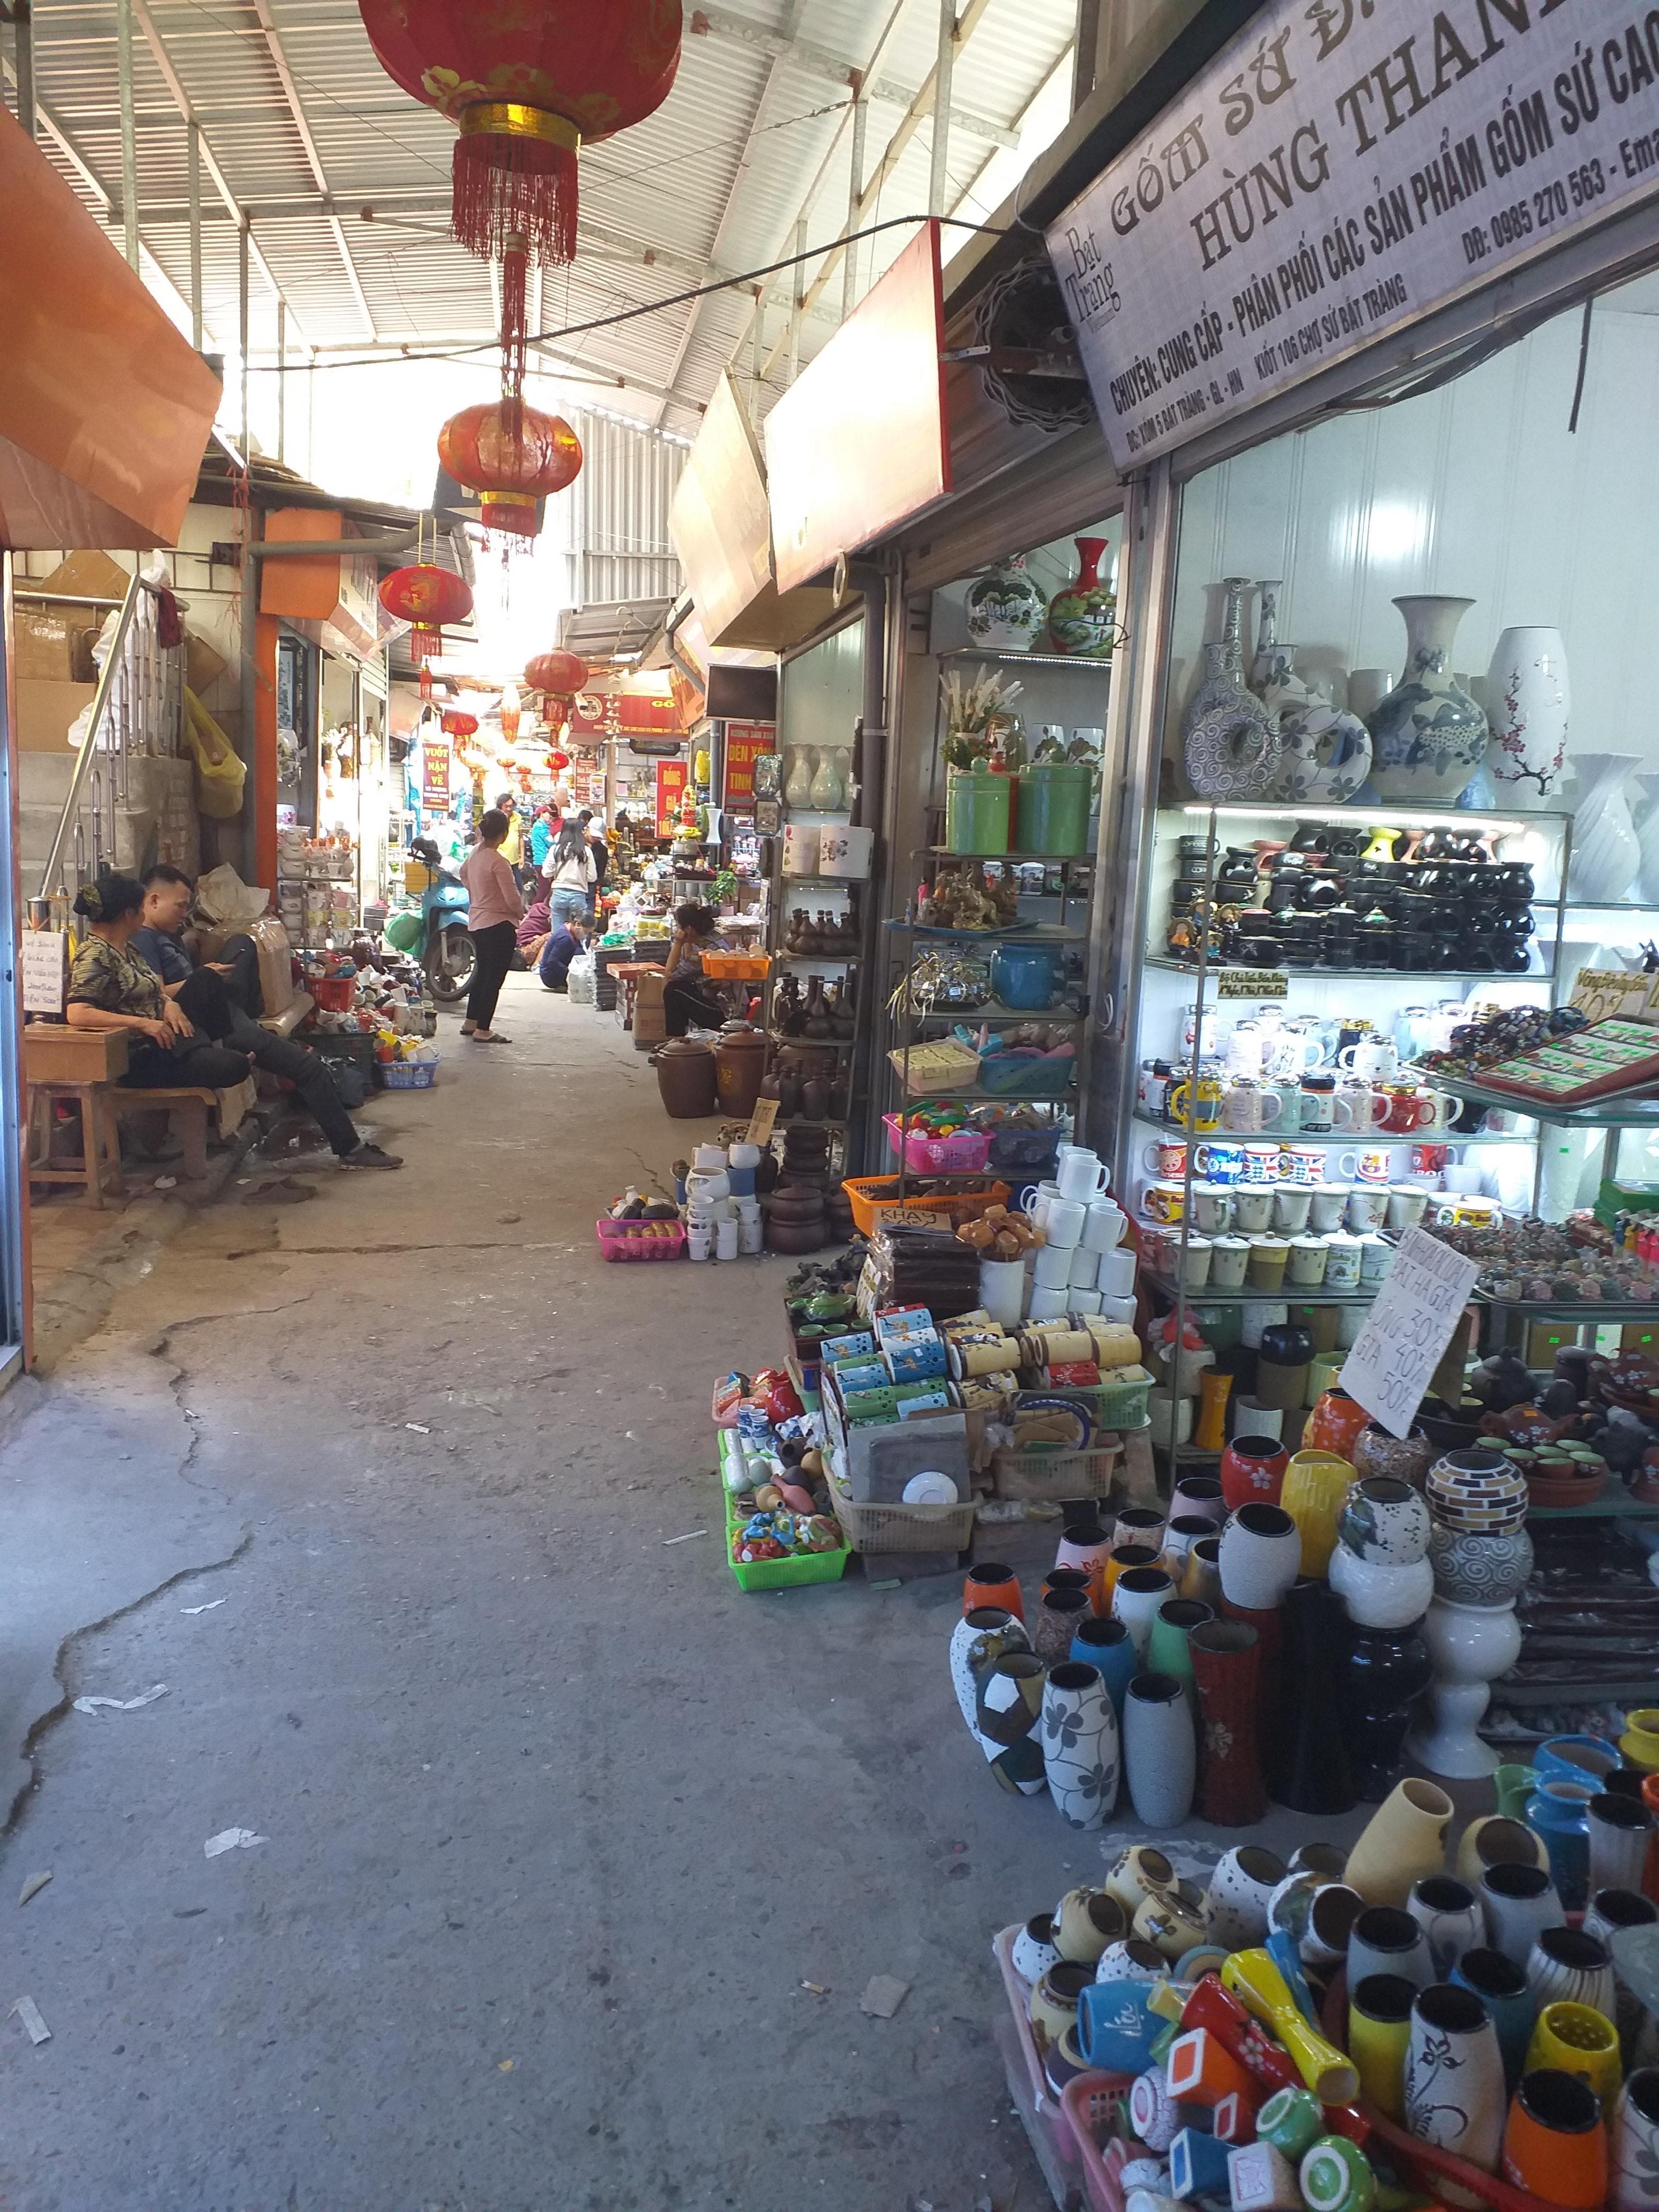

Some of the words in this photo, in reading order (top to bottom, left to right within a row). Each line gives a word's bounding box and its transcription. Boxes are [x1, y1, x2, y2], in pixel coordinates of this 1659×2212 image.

[1190, 119, 1330, 271] HÙNG
[1335, 0, 1567, 157] THAN
[1110, 355, 1162, 415] CHUYÊN:
[1157, 330, 1198, 384] CUNG
[1194, 301, 1223, 361] CẤP
[1232, 272, 1282, 337] PHÂN
[1277, 230, 1326, 309] PHỐI
[1322, 216, 1365, 282] CÁC
[1363, 175, 1415, 256] SẢN
[1410, 126, 1488, 226] PHẨM
[1485, 83, 1555, 178] GỐM
[1554, 40, 1600, 135] SỨ
[1490, 200, 1533, 248] 0985
[1533, 180, 1568, 227] 270
[1568, 158, 1605, 207] 563
[1277, 335, 1299, 367] 106
[1297, 319, 1323, 354] CHỢ
[1321, 304, 1339, 343] SỨ
[1339, 296, 1363, 335] BÁT
[1362, 273, 1408, 318] TRÀNG
[1138, 416, 1158, 446] XÓM
[1155, 414, 1164, 435] 5
[1161, 402, 1179, 431] BÁT
[1176, 389, 1206, 422] TRÀNG
[1209, 379, 1225, 405] GL
[1227, 368, 1245, 396] HN
[881, 1208, 937, 1224] KHAY
